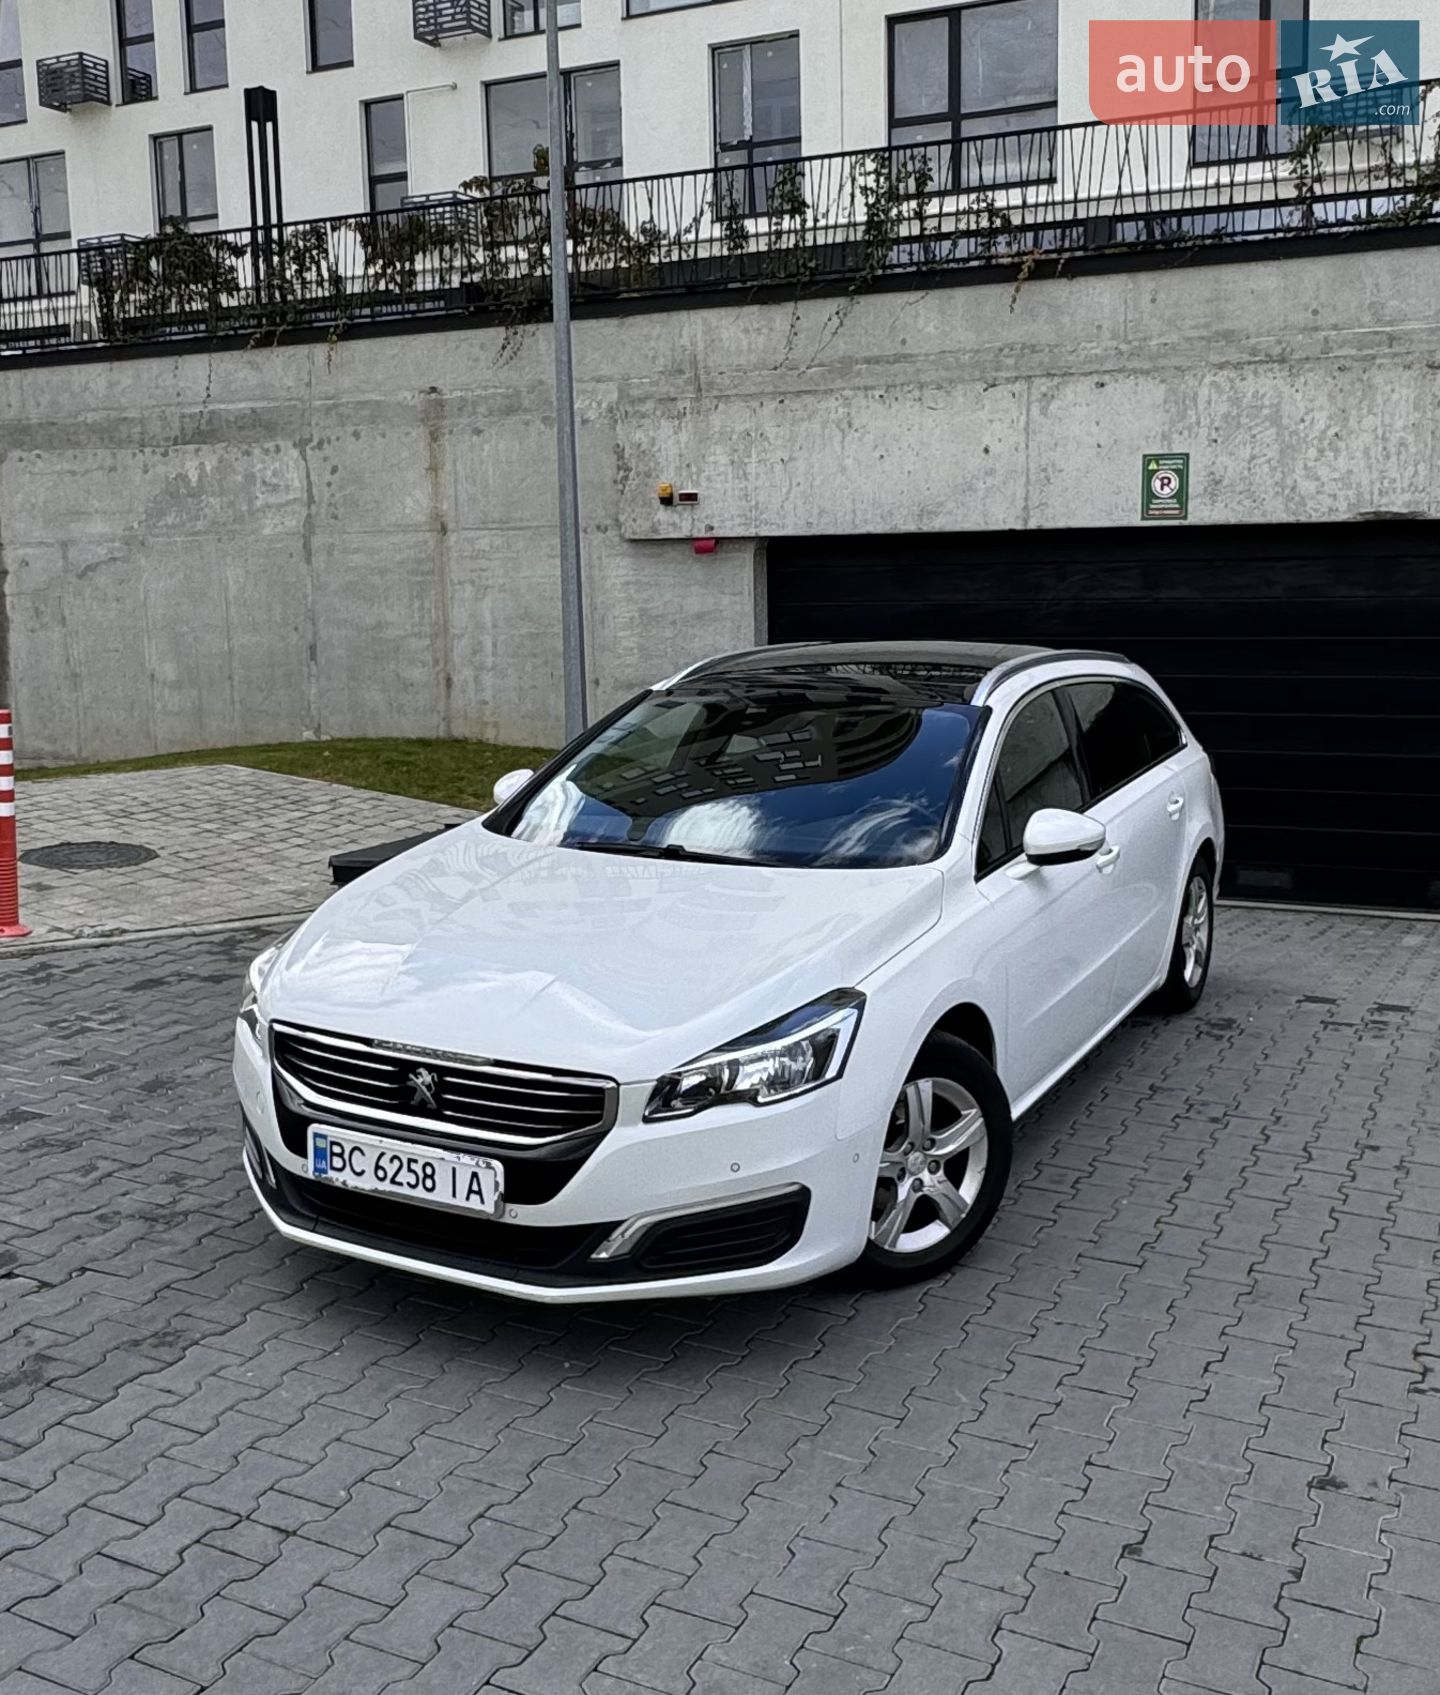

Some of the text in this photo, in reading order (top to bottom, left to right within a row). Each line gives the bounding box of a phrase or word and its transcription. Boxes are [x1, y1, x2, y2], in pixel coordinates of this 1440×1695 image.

[315, 1158, 327, 1170] UA
[329, 1140, 485, 1205] BC 6258 IA
